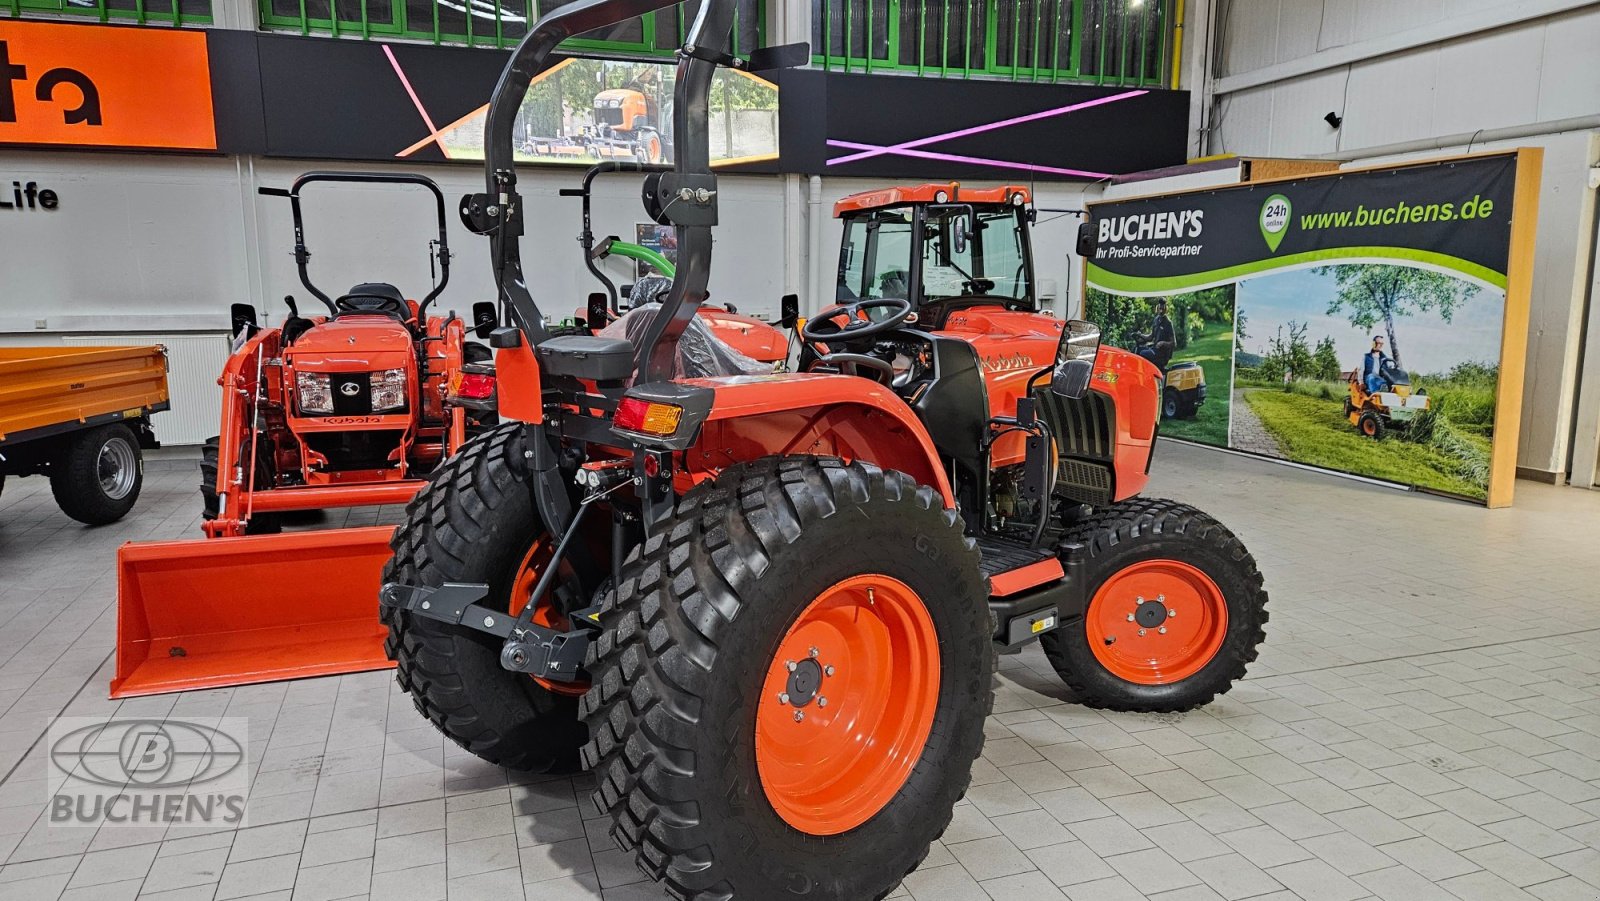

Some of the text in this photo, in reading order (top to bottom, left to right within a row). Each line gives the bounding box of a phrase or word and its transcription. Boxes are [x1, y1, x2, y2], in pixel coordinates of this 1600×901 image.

[1266, 205, 1287, 218] 24h
[1301, 194, 1494, 230] www.buchens.de
[1098, 209, 1204, 243] BUCHEN'S
[1266, 219, 1284, 228] online
[1096, 243, 1203, 260] Ihr Profi-Servicepartner
[323, 416, 381, 424] Kubota
